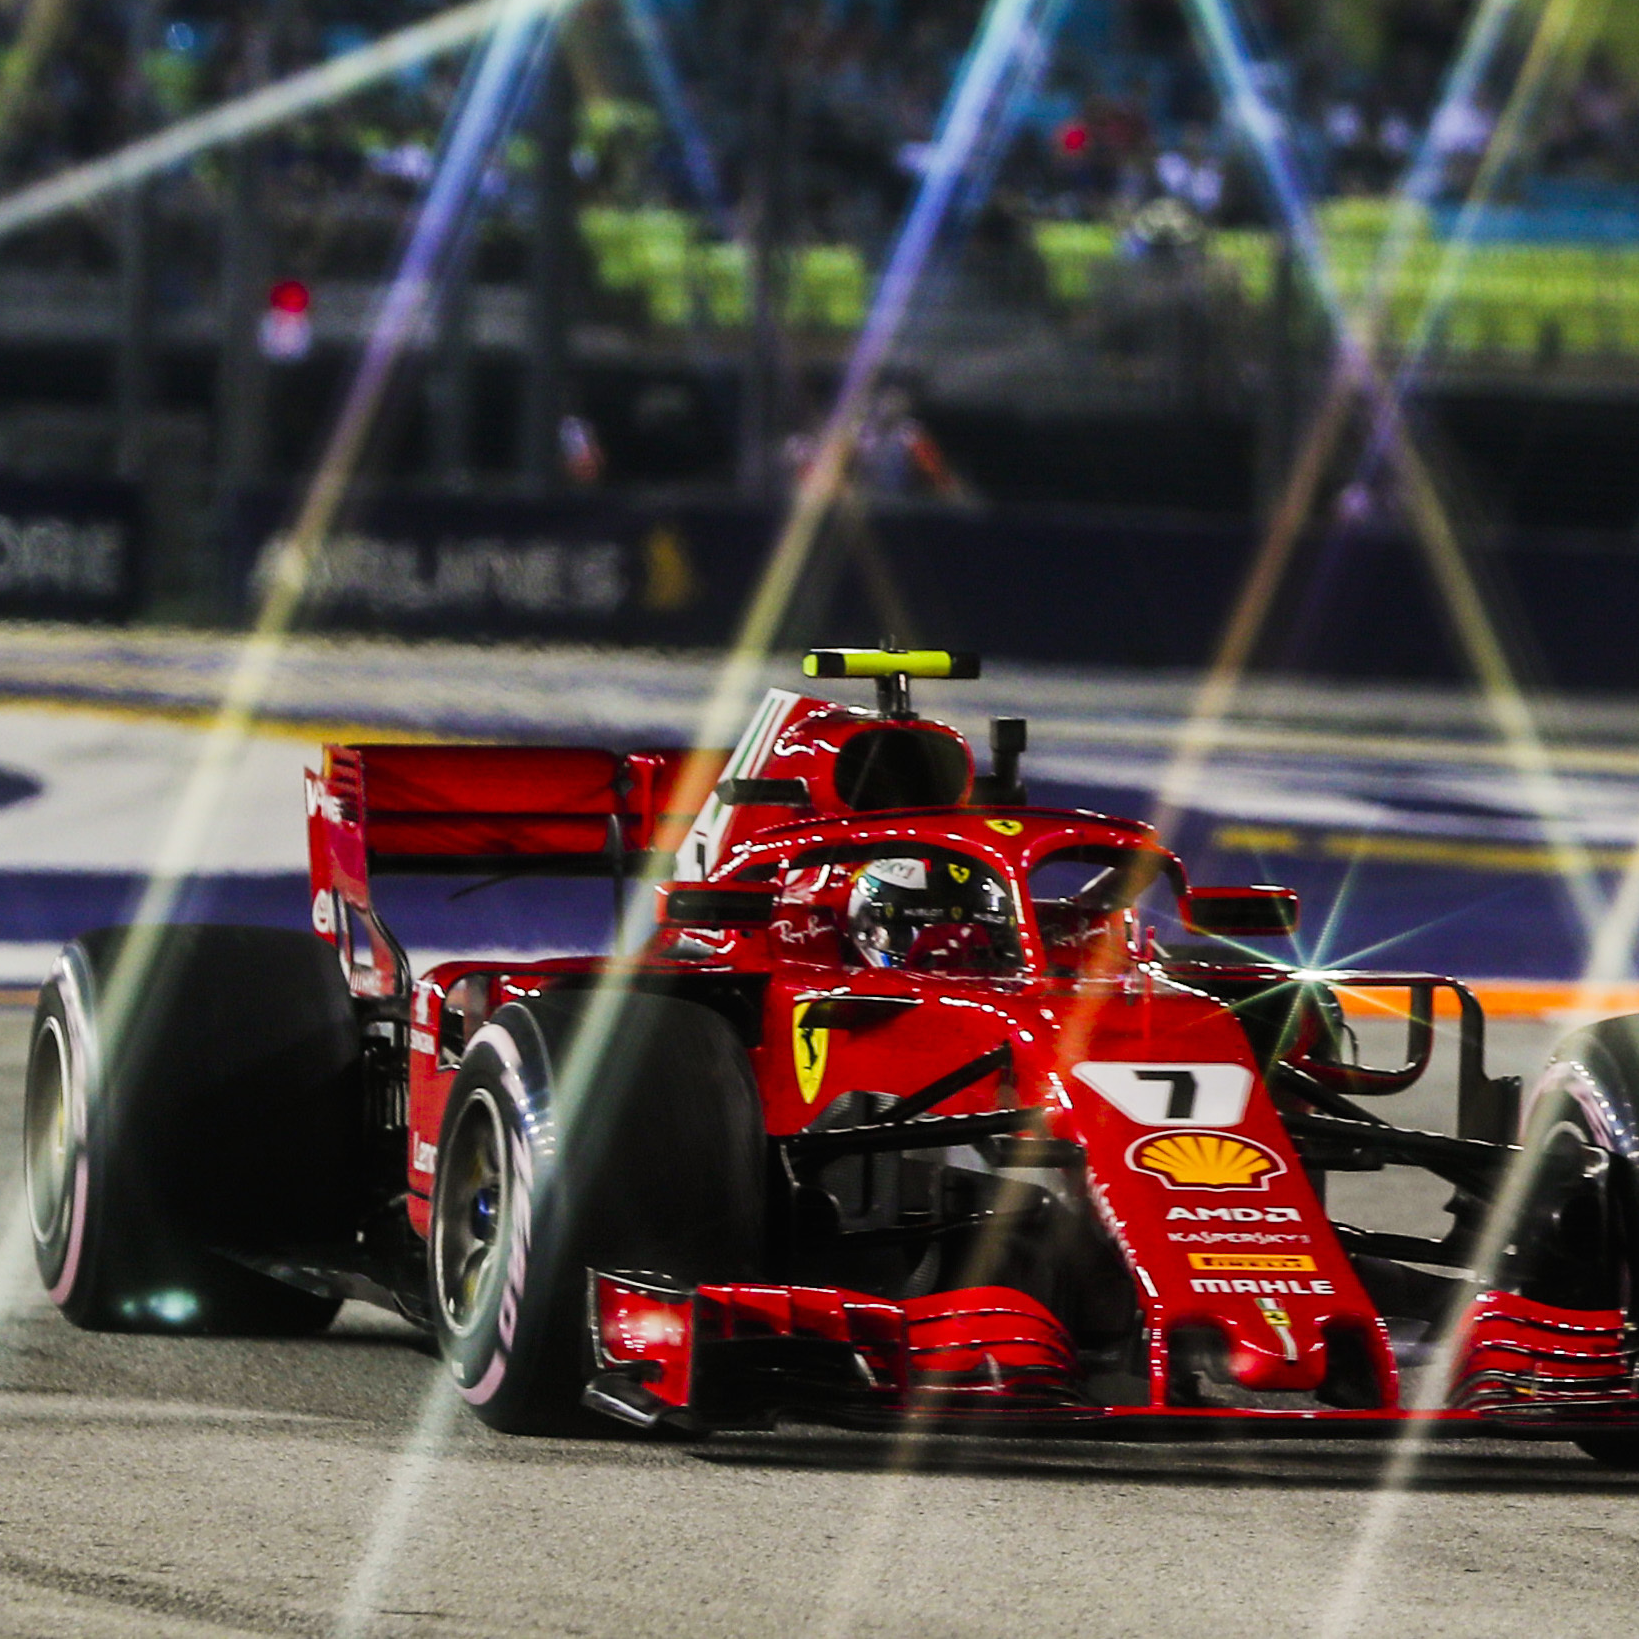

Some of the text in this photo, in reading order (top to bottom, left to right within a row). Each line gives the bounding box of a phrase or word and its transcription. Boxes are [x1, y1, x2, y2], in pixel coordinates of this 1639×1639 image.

[1133, 1070, 1198, 1119] 7
[1165, 1206, 1265, 1222] AMD
[1189, 1278, 1336, 1295] MAHLE
